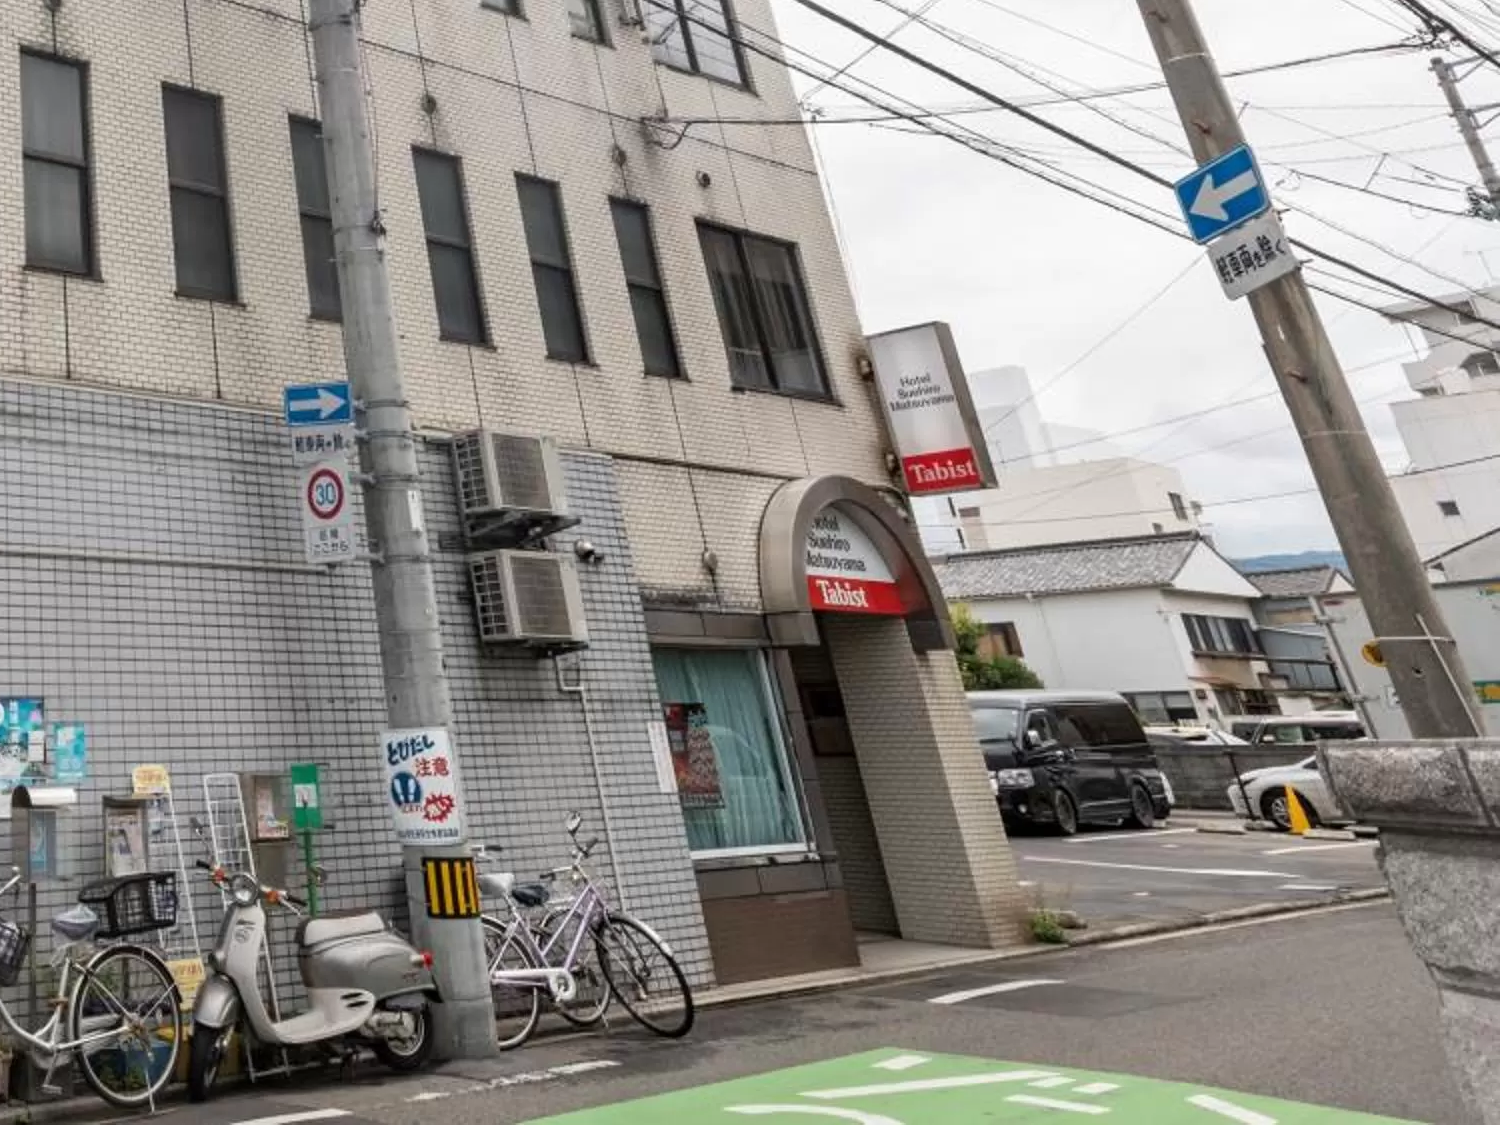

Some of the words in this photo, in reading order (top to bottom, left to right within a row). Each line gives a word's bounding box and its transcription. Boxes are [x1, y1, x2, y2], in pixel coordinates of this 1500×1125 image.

[900, 373, 932, 387] Hotel
[890, 394, 955, 412] Matsuyama
[897, 385, 941, 399] Suehiro
[908, 459, 977, 484] Tabist
[315, 482, 337, 507] 30
[815, 578, 869, 608] Tabist
[386, 734, 435, 766] とびだし
[414, 756, 449, 777] 注意
